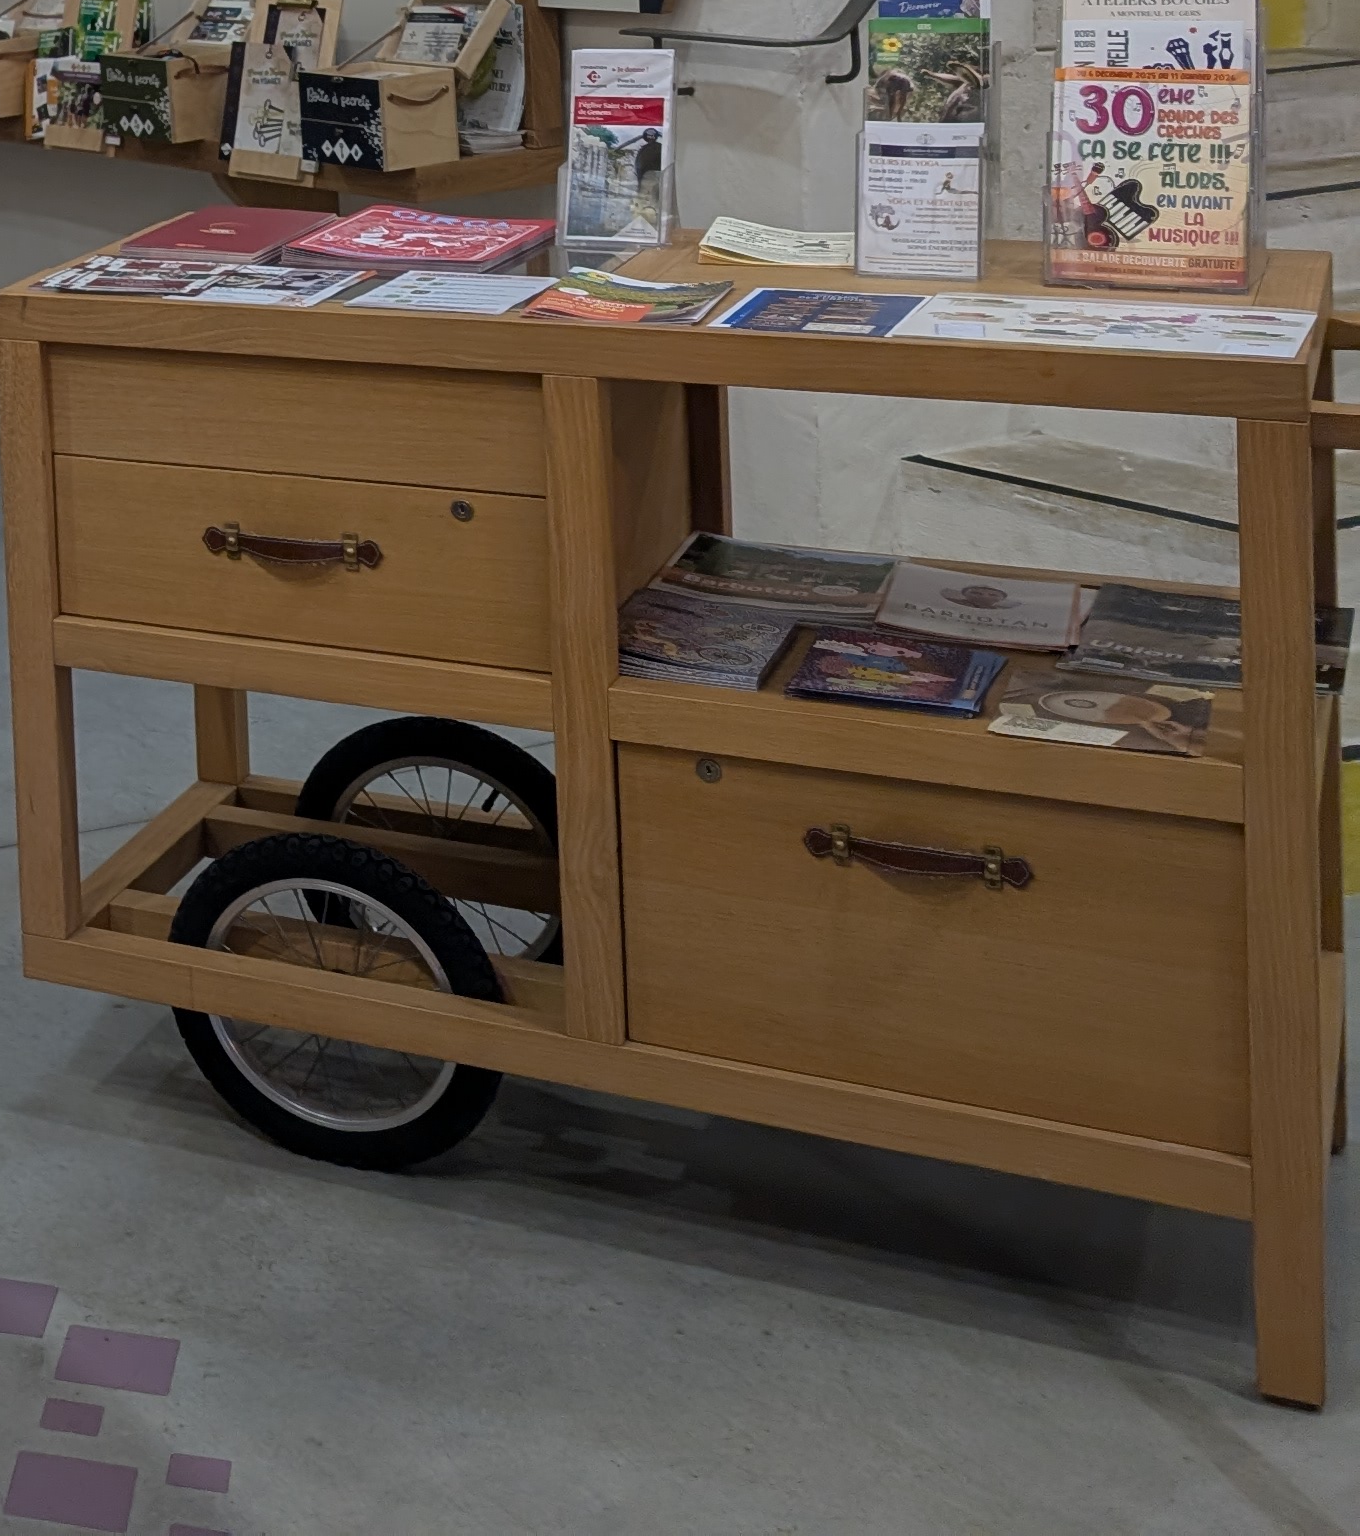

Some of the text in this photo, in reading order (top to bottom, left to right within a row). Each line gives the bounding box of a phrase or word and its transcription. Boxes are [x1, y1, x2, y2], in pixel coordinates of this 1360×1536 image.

[1075, 83, 1155, 137] 30
[1209, 109, 1240, 125] DES
[1209, 142, 1232, 165] !!!
[900, 158, 911, 167] DE
[912, 158, 940, 168] YOGA
[1181, 194, 1235, 211] AVANT
[1184, 211, 1204, 227] LA
[1081, 251, 1122, 265] BALADE
[903, 601, 1049, 629] BARBOTAN
[1089, 638, 1184, 660] Union
